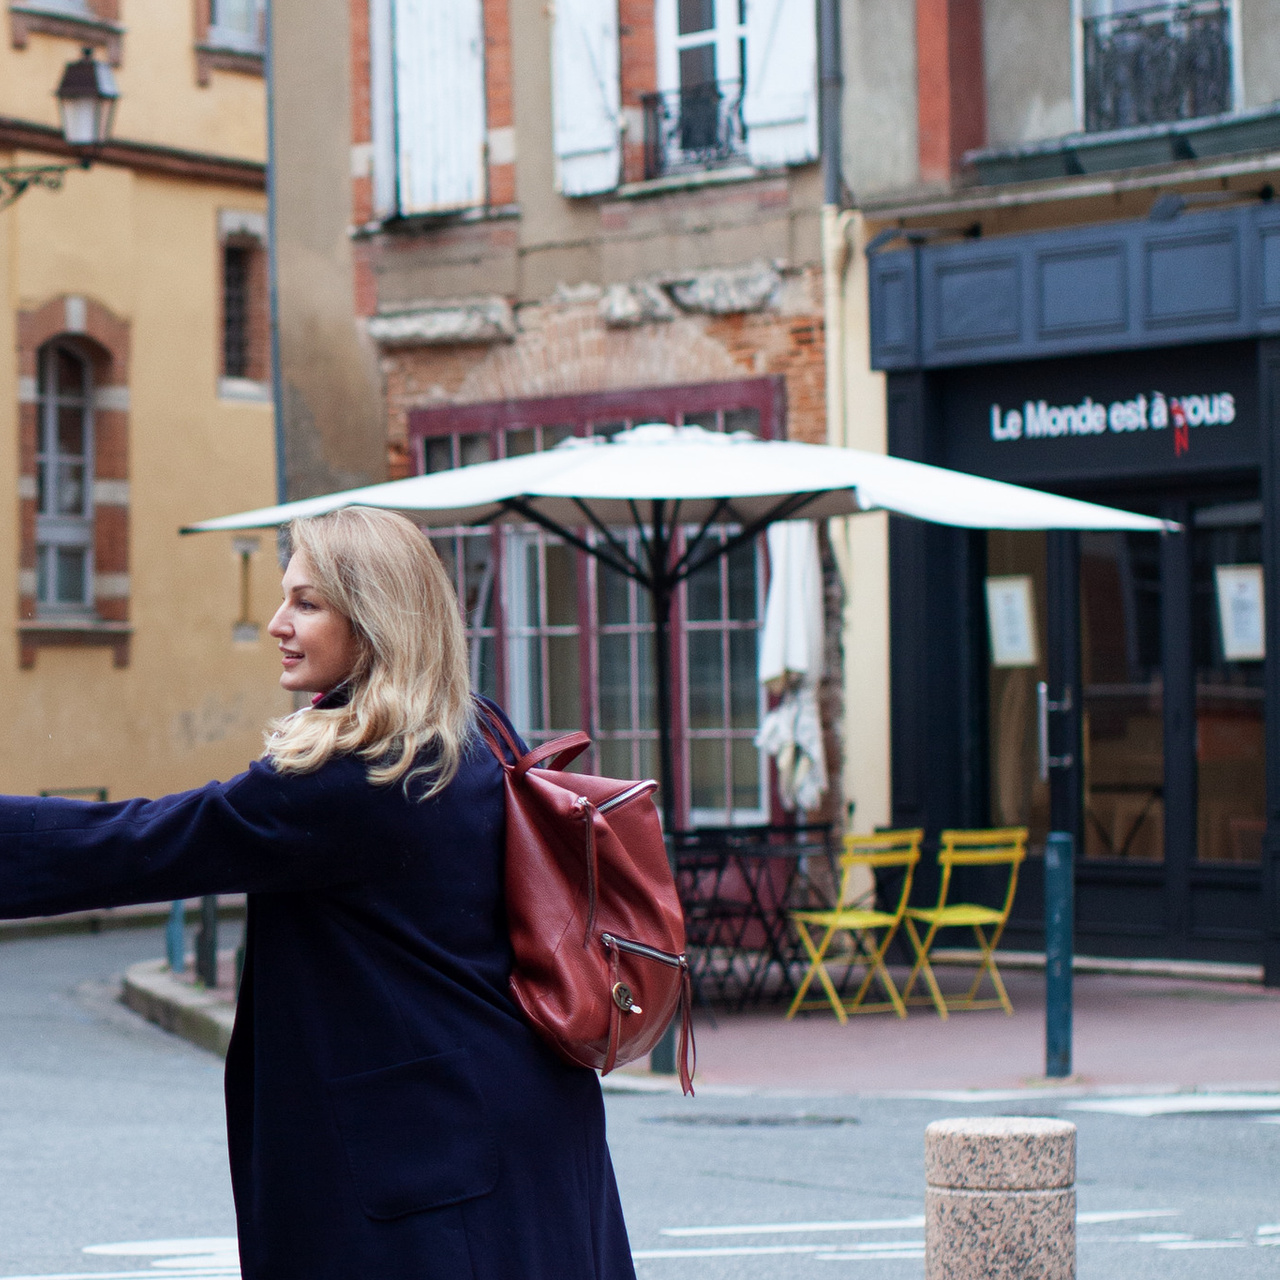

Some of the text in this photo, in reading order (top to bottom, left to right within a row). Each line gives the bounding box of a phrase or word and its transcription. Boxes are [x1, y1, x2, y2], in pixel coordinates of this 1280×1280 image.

[990, 404, 1022, 441] Le
[1024, 396, 1107, 439] Monde
[1108, 393, 1148, 433] est
[1150, 390, 1169, 430] à
